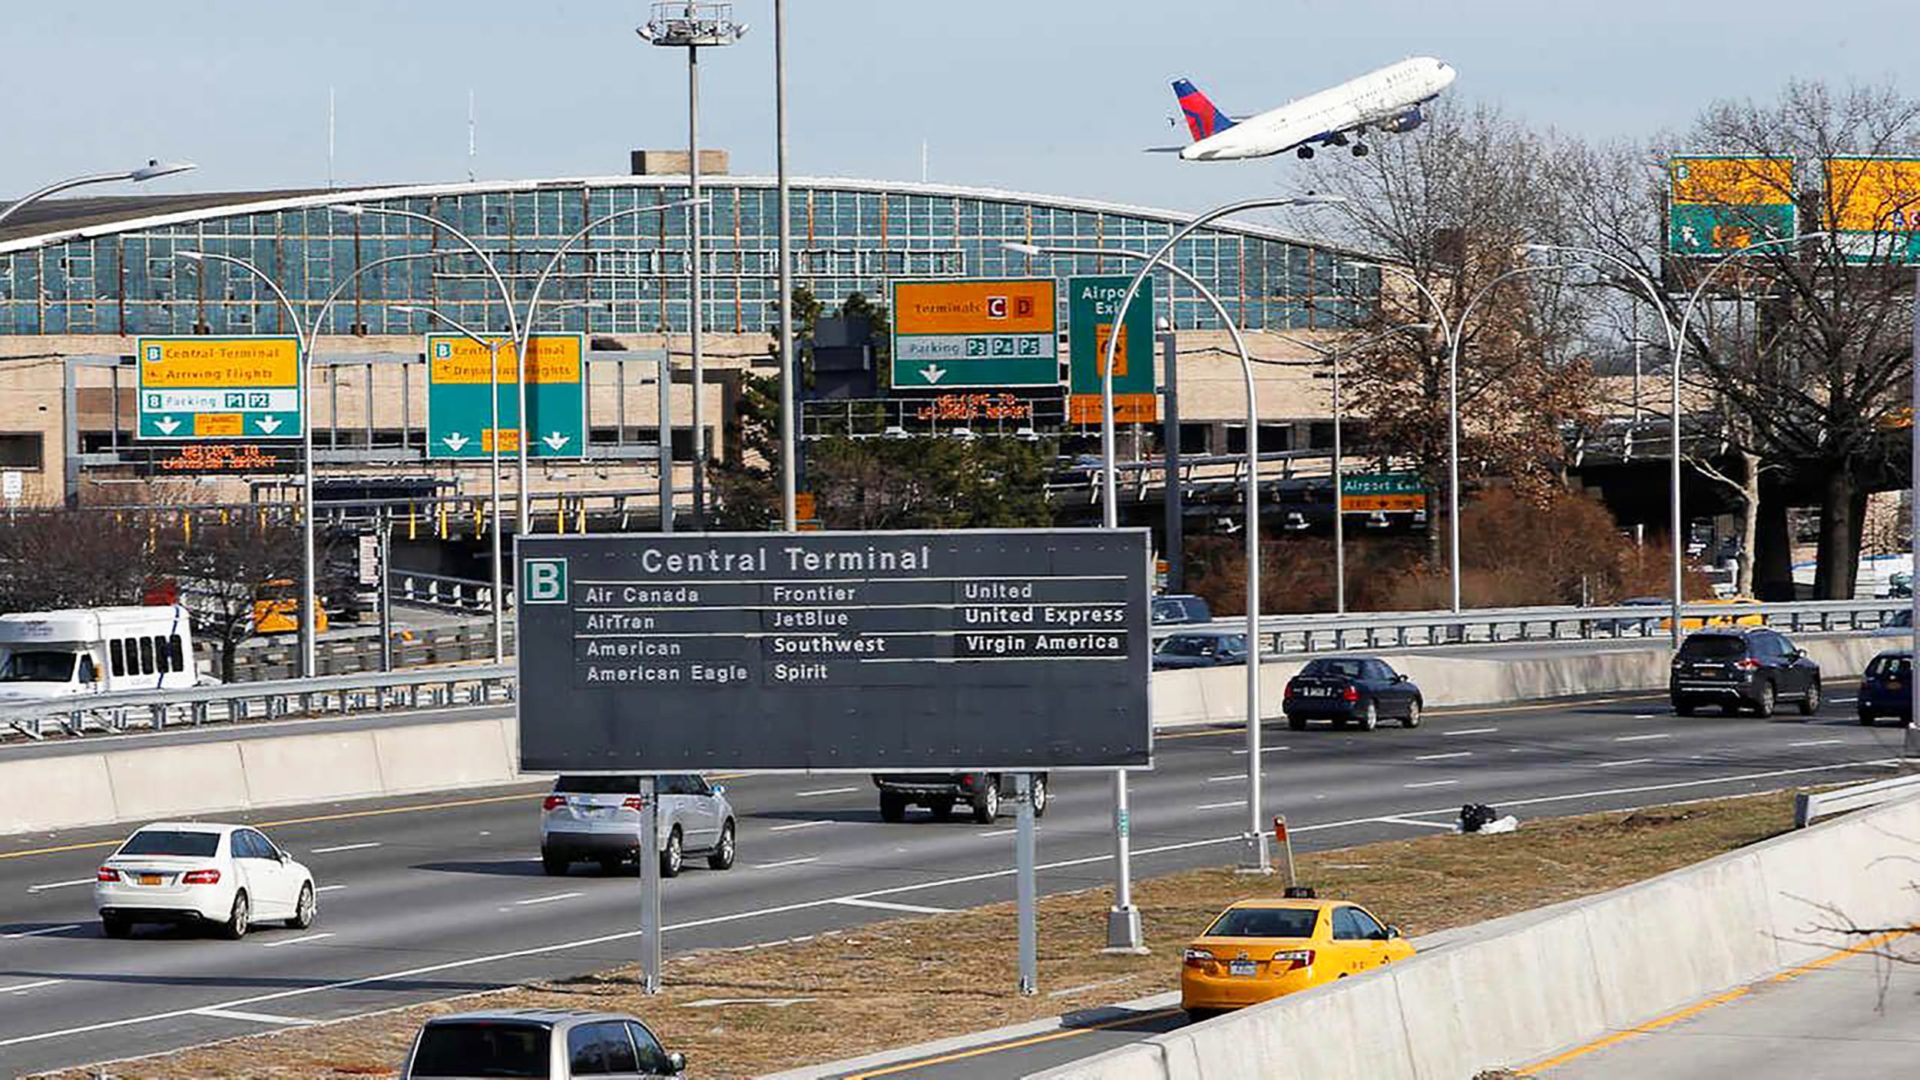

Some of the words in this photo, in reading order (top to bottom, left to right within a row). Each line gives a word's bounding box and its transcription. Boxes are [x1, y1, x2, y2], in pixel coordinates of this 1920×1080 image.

[1082, 286, 1140, 301] Airpot
[915, 303, 981, 314] Terminals
[990, 299, 1005, 315] C
[1018, 299, 1031, 315] D
[1095, 301, 1120, 315] Exi
[165, 348, 214, 359] Central
[218, 348, 280, 359] Terminal
[911, 342, 960, 355] Parking
[968, 340, 986, 354] P3
[994, 339, 1012, 354] P4
[1020, 338, 1040, 353] P5
[166, 370, 222, 381] Arriving
[226, 369, 273, 380] Flights
[166, 396, 217, 407] Parking
[226, 394, 244, 407] P1
[251, 394, 269, 407] P2
[1343, 480, 1390, 491] Airport
[531, 562, 560, 600] B
[642, 547, 766, 573] Central
[784, 545, 929, 571] Terminal
[586, 587, 613, 603] Air
[623, 587, 699, 603] Canada
[773, 585, 856, 602] Frontier
[965, 582, 1033, 599] United
[586, 613, 655, 629] AirTran
[773, 610, 849, 627] JetBlue
[965, 608, 1034, 624] United
[1044, 605, 1125, 624] Express
[587, 640, 681, 656] American
[774, 636, 886, 653] Southwest
[966, 634, 1026, 654] Virgin
[1035, 633, 1120, 650] America
[587, 665, 680, 681] American
[691, 665, 748, 683] Eagle
[774, 663, 828, 682] Spirit
